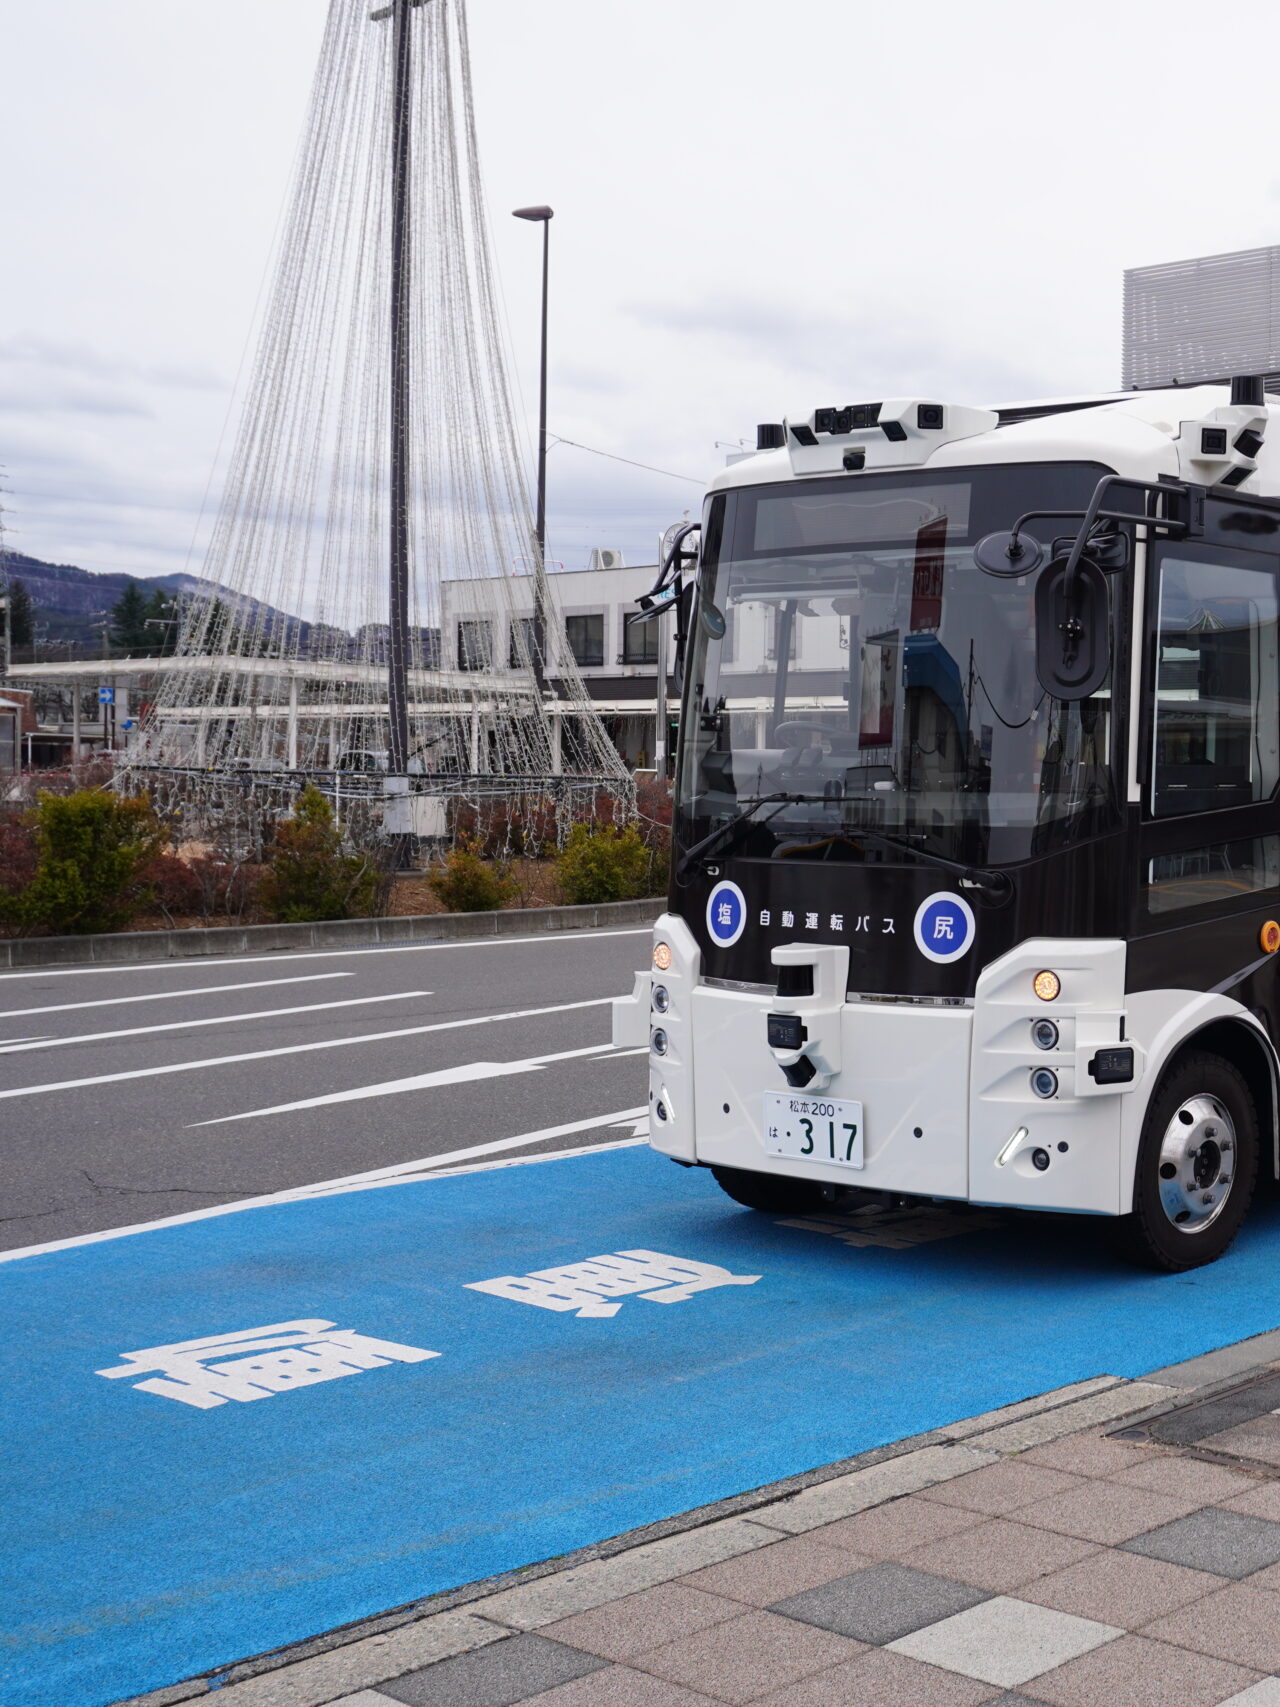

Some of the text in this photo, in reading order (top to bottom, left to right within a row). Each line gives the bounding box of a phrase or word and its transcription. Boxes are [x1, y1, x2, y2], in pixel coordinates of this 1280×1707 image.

[718, 903, 733, 925] 塩
[760, 910, 896, 934] 自動運転バス
[933, 916, 954, 940] 尻
[769, 1126, 778, 1138] は
